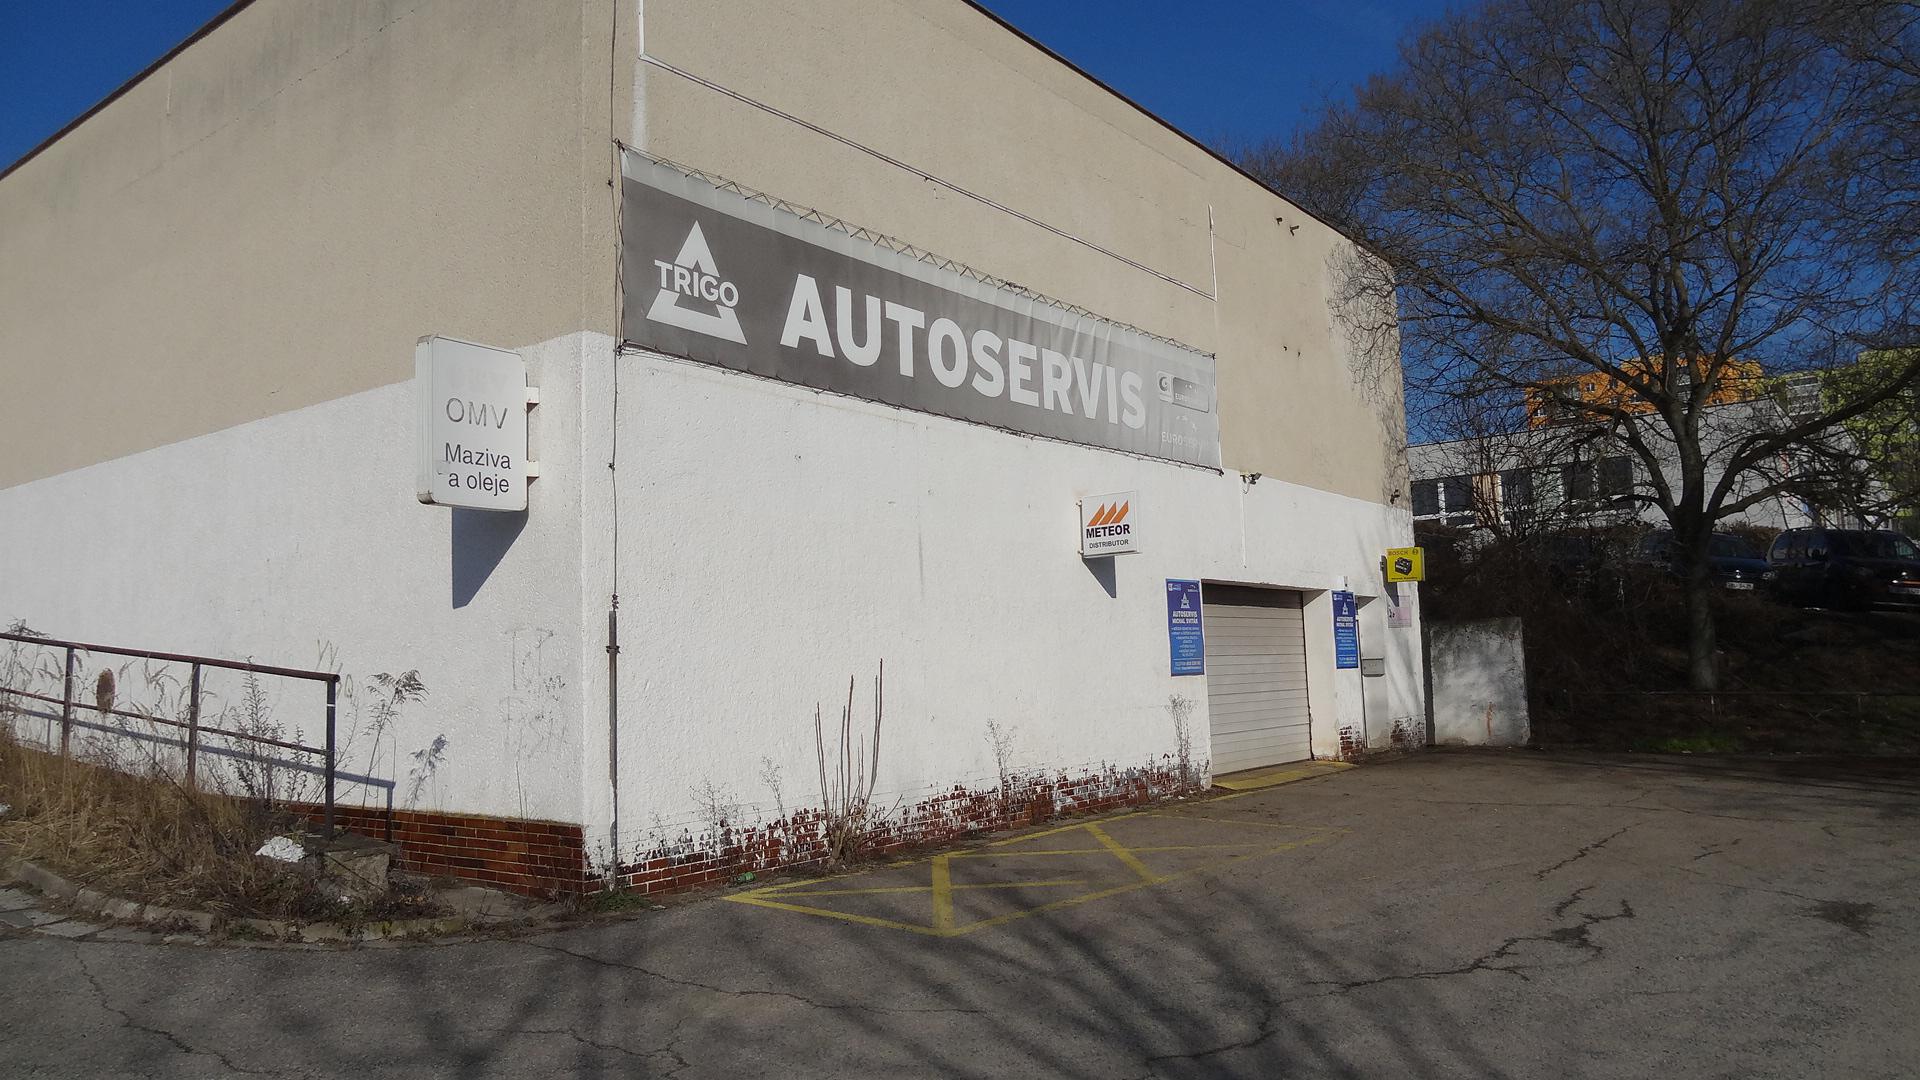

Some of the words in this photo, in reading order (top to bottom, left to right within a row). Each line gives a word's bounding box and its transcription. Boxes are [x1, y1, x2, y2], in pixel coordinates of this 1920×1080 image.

[654, 259, 739, 308] TRIGO
[780, 273, 1145, 430] AUTOSERVIS
[446, 397, 508, 429] OMV
[445, 442, 511, 469] Maziva
[448, 472, 460, 487] a
[466, 471, 510, 496] oleje
[1086, 523, 1130, 539] METEOR
[1089, 539, 1129, 549] DISTRIBUTOR
